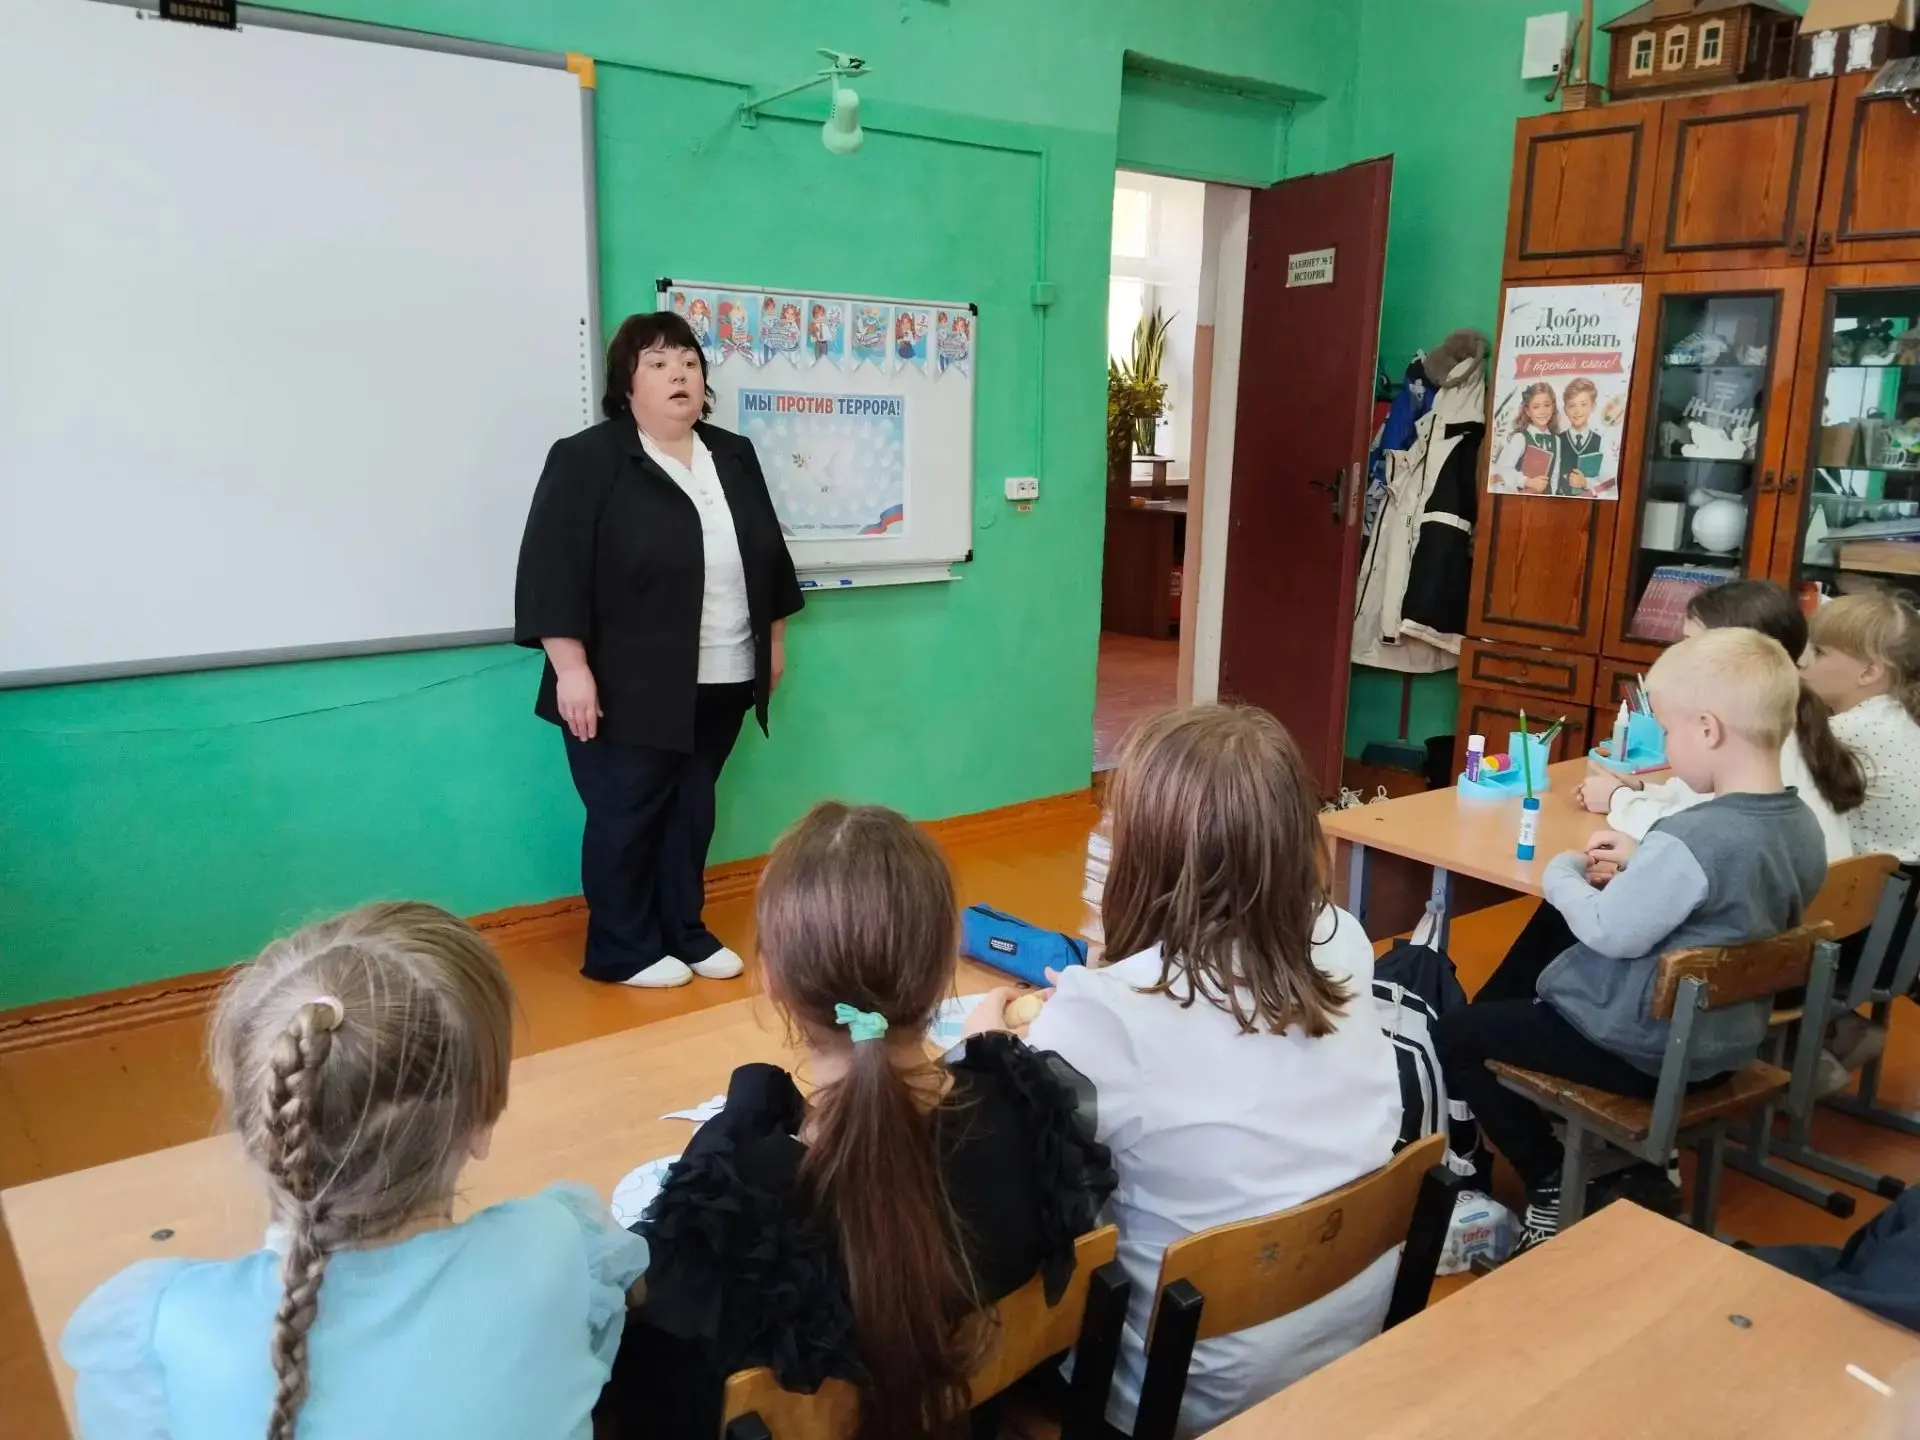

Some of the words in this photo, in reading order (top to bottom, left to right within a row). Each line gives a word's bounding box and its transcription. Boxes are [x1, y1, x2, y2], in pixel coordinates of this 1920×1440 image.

[1290, 257, 1321, 270] КАБИНЕТ
[1294, 269, 1326, 282] ИСТОРИЯ
[1536, 307, 1601, 334] Добро
[1514, 332, 1621, 348] пожаловать
[1533, 356, 1576, 376] третий
[744, 393, 772, 412] МЫ
[776, 395, 834, 414] ПРОТИВ
[837, 398, 901, 416] ТЕРРОРА!
